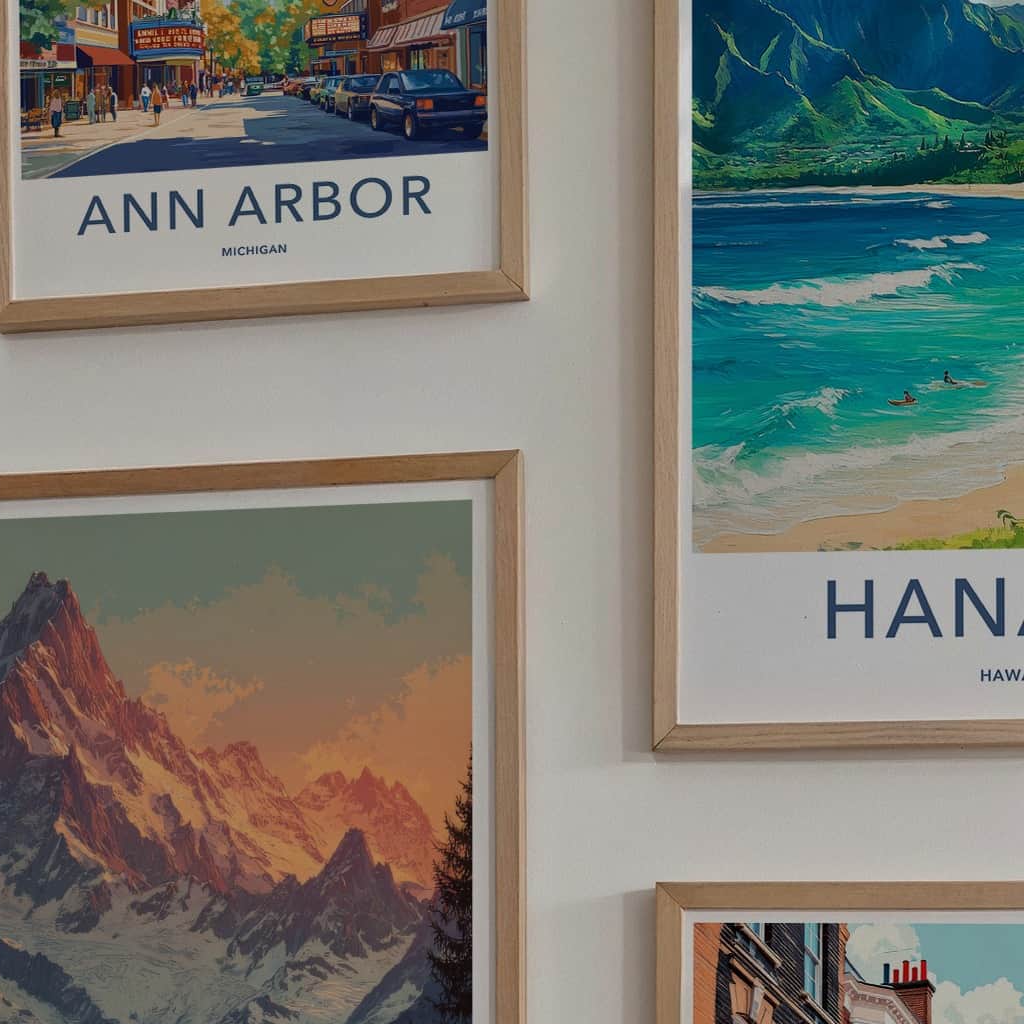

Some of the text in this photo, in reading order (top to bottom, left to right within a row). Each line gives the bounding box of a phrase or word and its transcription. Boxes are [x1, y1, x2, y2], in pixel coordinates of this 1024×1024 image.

[77, 175, 432, 236] ANN ARBOR
[221, 244, 287, 257] MICHIGAN
[827, 577, 1024, 639] HAN
[980, 668, 1024, 682] HAW
